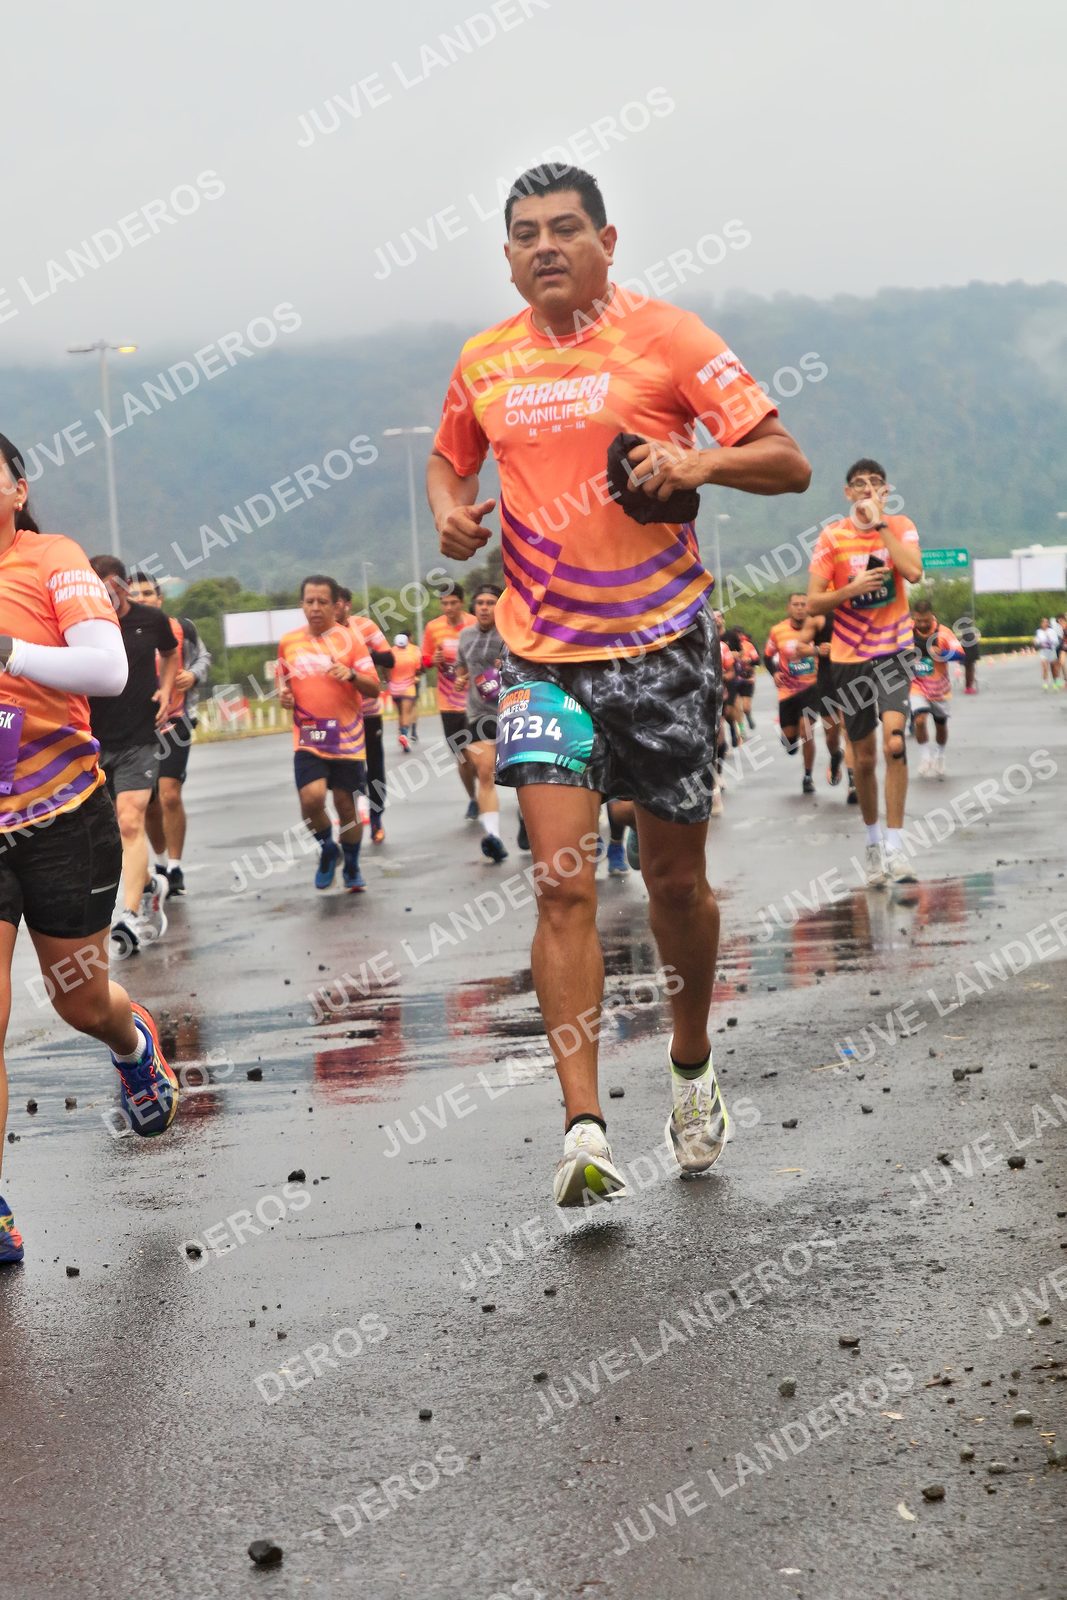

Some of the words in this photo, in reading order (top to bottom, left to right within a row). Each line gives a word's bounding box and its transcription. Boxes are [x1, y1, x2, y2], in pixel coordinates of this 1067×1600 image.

[505, 371, 611, 408] CARRERA
[505, 401, 584, 426] OMNILIFE
[563, 695, 582, 714] 10K
[503, 715, 563, 744] 1234
